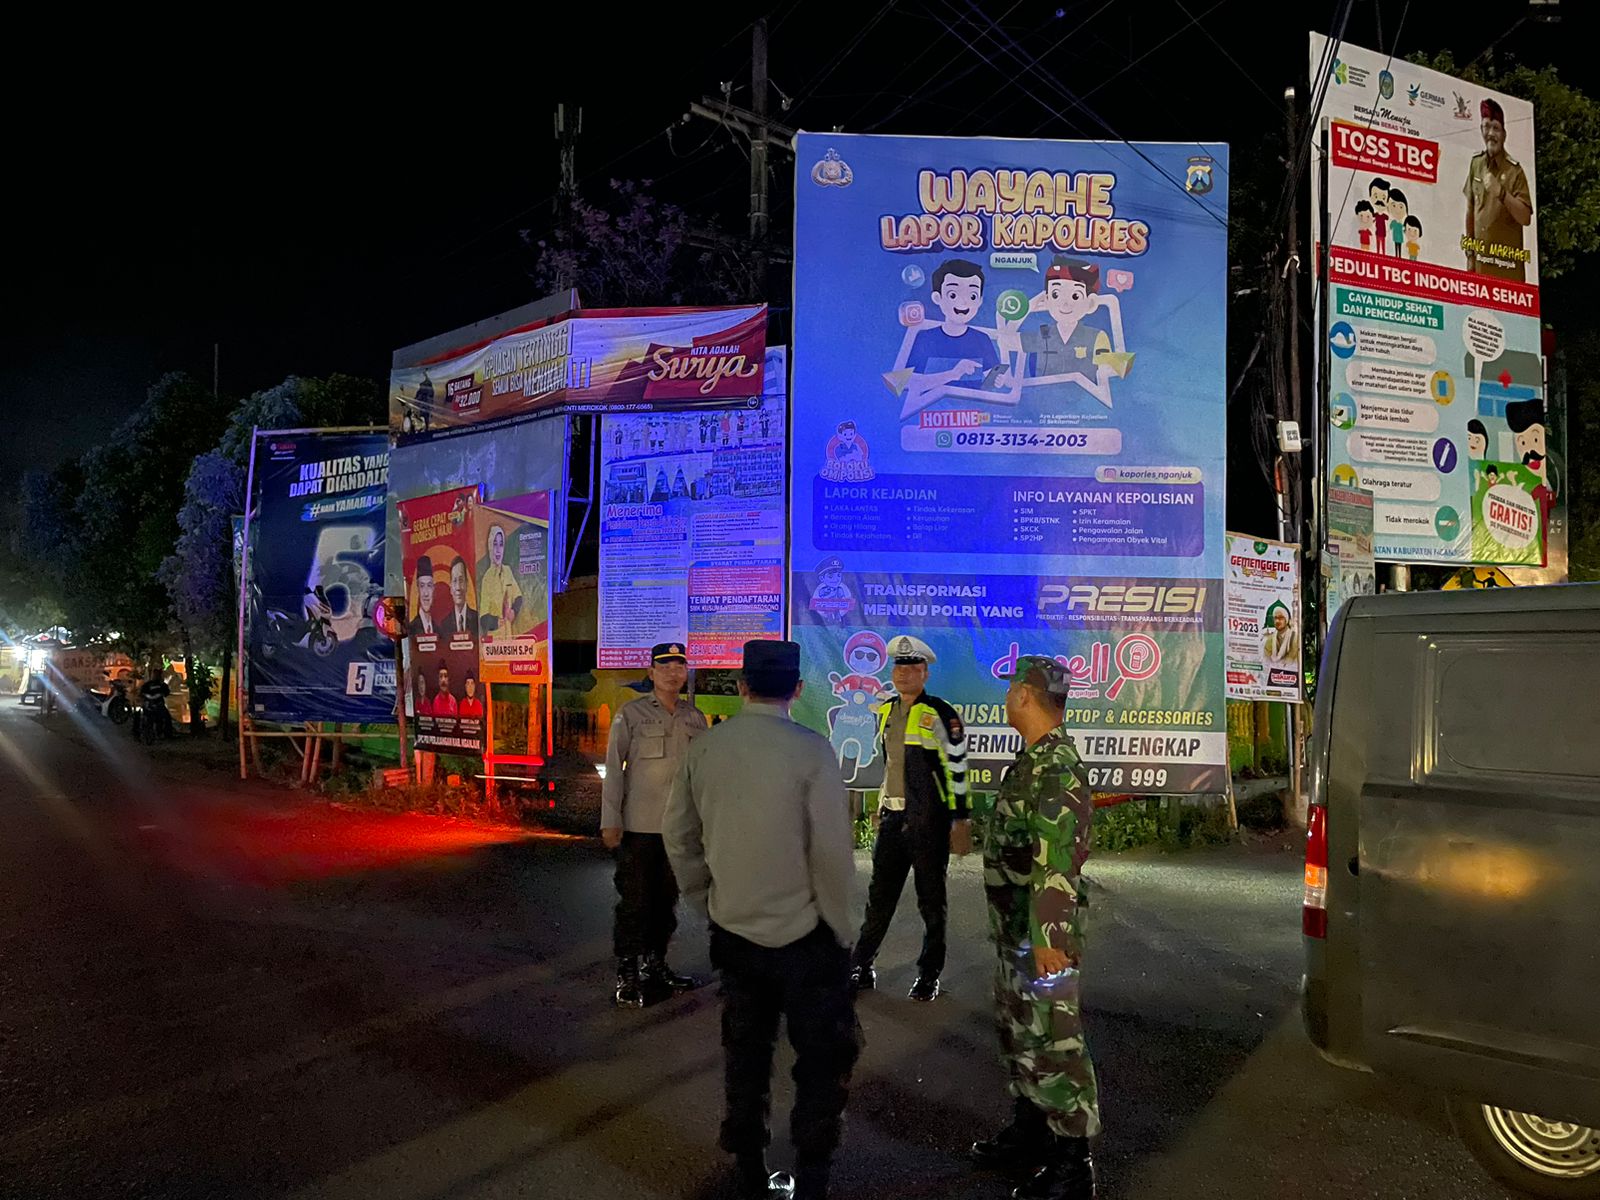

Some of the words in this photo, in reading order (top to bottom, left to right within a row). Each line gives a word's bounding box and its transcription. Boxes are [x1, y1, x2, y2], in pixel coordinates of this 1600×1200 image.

[1420, 91, 1445, 105] GERMAS
[1354, 105, 1380, 117] BERSATU
[1354, 114, 1380, 126] Indonesia
[1337, 127, 1390, 159] TOSS
[1395, 141, 1434, 170] TBC
[918, 170, 1115, 217] WAYAHE
[881, 216, 983, 251] LAPOR
[992, 215, 1150, 254] KAPOLRES
[995, 256, 1033, 265] NGANJUK
[1382, 265, 1411, 285] TBC
[1414, 271, 1490, 300] INDONESIA
[1492, 287, 1534, 308] SEHAT
[1349, 292, 1373, 306] GAYA
[1375, 296, 1403, 310] HIDUP
[1405, 301, 1433, 315] SEHAT
[1342, 304, 1364, 317] DAN
[1365, 308, 1425, 326] PENCEGAHAN
[1427, 316, 1438, 328] TB
[1378, 333, 1400, 341] makanan
[690, 346, 708, 356] KITA
[709, 345, 740, 356] ADALAH
[648, 347, 758, 394] Surya
[1360, 404, 1388, 413] Menjemur
[1401, 408, 1414, 416] tidur
[923, 412, 978, 427] HOTLINE
[1374, 413, 1388, 421] tidak
[1389, 415, 1410, 424] lembab
[956, 432, 1088, 448] 0813-3134-2003
[300, 455, 361, 481] KUALITAS
[840, 469, 875, 481] POLISI
[289, 479, 324, 497] DAPAT
[326, 468, 389, 494] DIANDALK
[1362, 478, 1389, 489] Olahraga
[1391, 480, 1412, 489] teratur
[825, 488, 868, 499] LAPOR
[872, 489, 937, 500] KEJADIAN
[1014, 491, 1045, 503] INFO
[1048, 492, 1113, 504] LAYANAN
[1116, 493, 1194, 505] KEPOLISIAN
[607, 503, 663, 517] Menerima
[1490, 501, 1533, 532] GRATIS!
[1385, 515, 1401, 524] Tidak
[1402, 516, 1430, 525] merokok
[1079, 527, 1123, 535] Pengawalan
[1079, 536, 1125, 545] Pengamanan
[1127, 536, 1150, 545] Obyek
[1374, 546, 1391, 555] ATAN
[1393, 546, 1432, 556] KABUPATEN
[1230, 555, 1290, 572] GEMENGGENG
[864, 584, 987, 598] TRANSFORMASI
[690, 596, 720, 604] TEMPAT
[722, 594, 779, 604] PENDAFTARAN
[1038, 585, 1208, 613] PRESISI
[864, 604, 928, 617] MENUJU
[931, 604, 977, 617] POLRI
[980, 605, 1024, 618] YANG
[1228, 618, 1238, 631] 19
[1239, 622, 1259, 633] 2023
[486, 645, 517, 656] SUMARSIH
[355, 665, 367, 692] 5
[1064, 709, 1100, 723] PTOP
[1105, 710, 1115, 724] &
[1119, 710, 1213, 727] ACCESSORIES
[964, 734, 1018, 753] ERMU
[1084, 736, 1201, 757] TERLENGKAP
[1088, 769, 1123, 786] 678
[1131, 769, 1168, 787] 999
